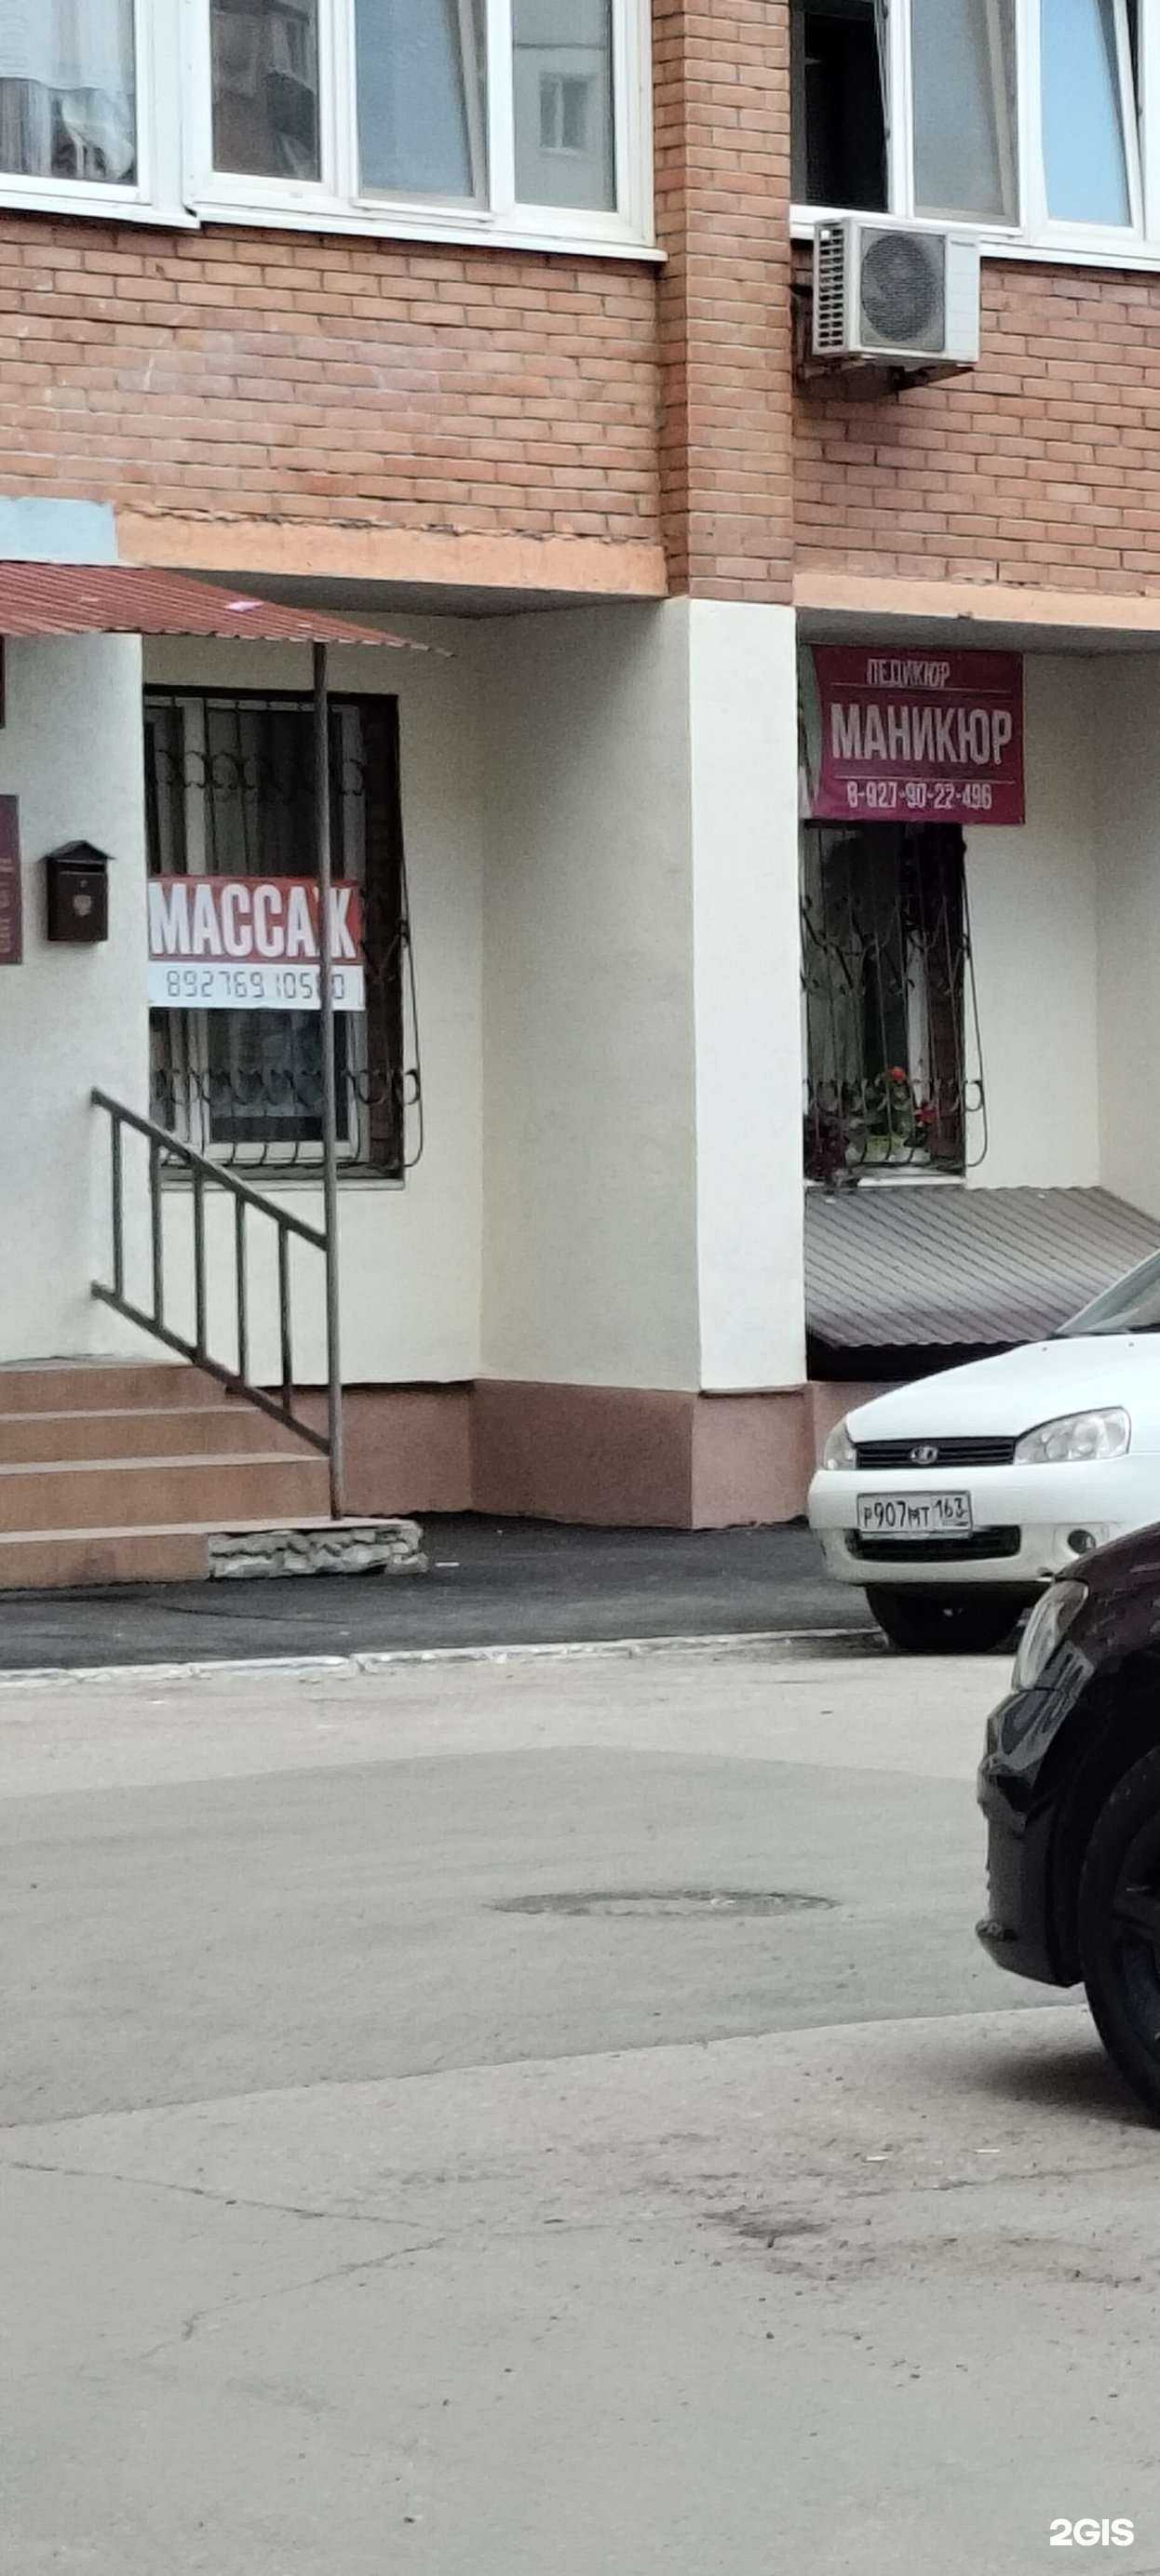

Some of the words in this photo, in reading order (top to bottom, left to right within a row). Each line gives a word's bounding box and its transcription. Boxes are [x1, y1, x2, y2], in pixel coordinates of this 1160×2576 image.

[867, 658, 951, 688] ПЕДИКЮР
[830, 702, 1013, 765] МАНИКЮР
[148, 880, 357, 959] МАССАЖ
[166, 970, 345, 1000] 8927691050
